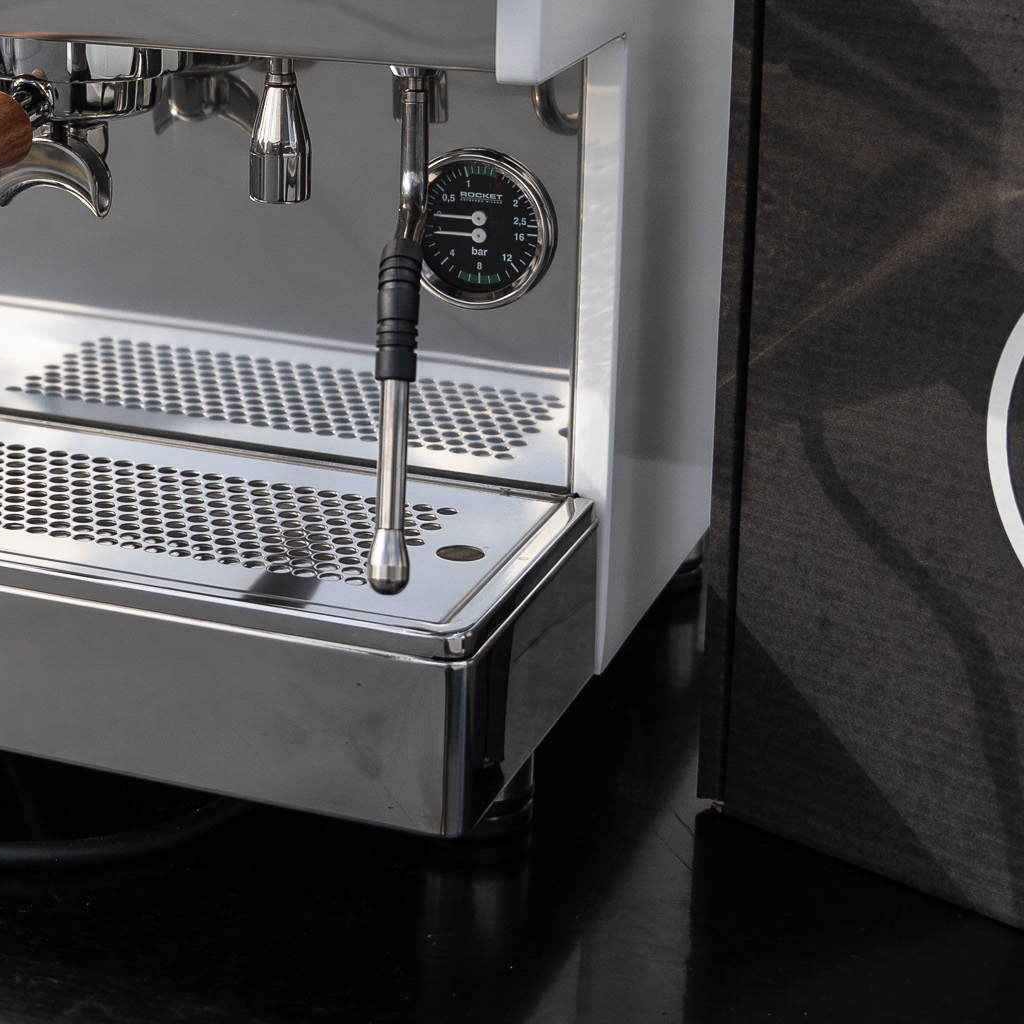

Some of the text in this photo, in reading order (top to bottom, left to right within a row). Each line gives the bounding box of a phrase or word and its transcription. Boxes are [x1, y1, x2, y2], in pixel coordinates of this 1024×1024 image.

[442, 193, 456, 203] 0,5
[460, 191, 503, 201] ROCKET
[512, 199, 519, 207] 2
[513, 217, 527, 226] 2,5
[514, 233, 525, 242] 16
[449, 249, 455, 257] 4
[471, 247, 488, 257] bar
[502, 254, 513, 262] 12
[476, 262, 483, 270] 8
